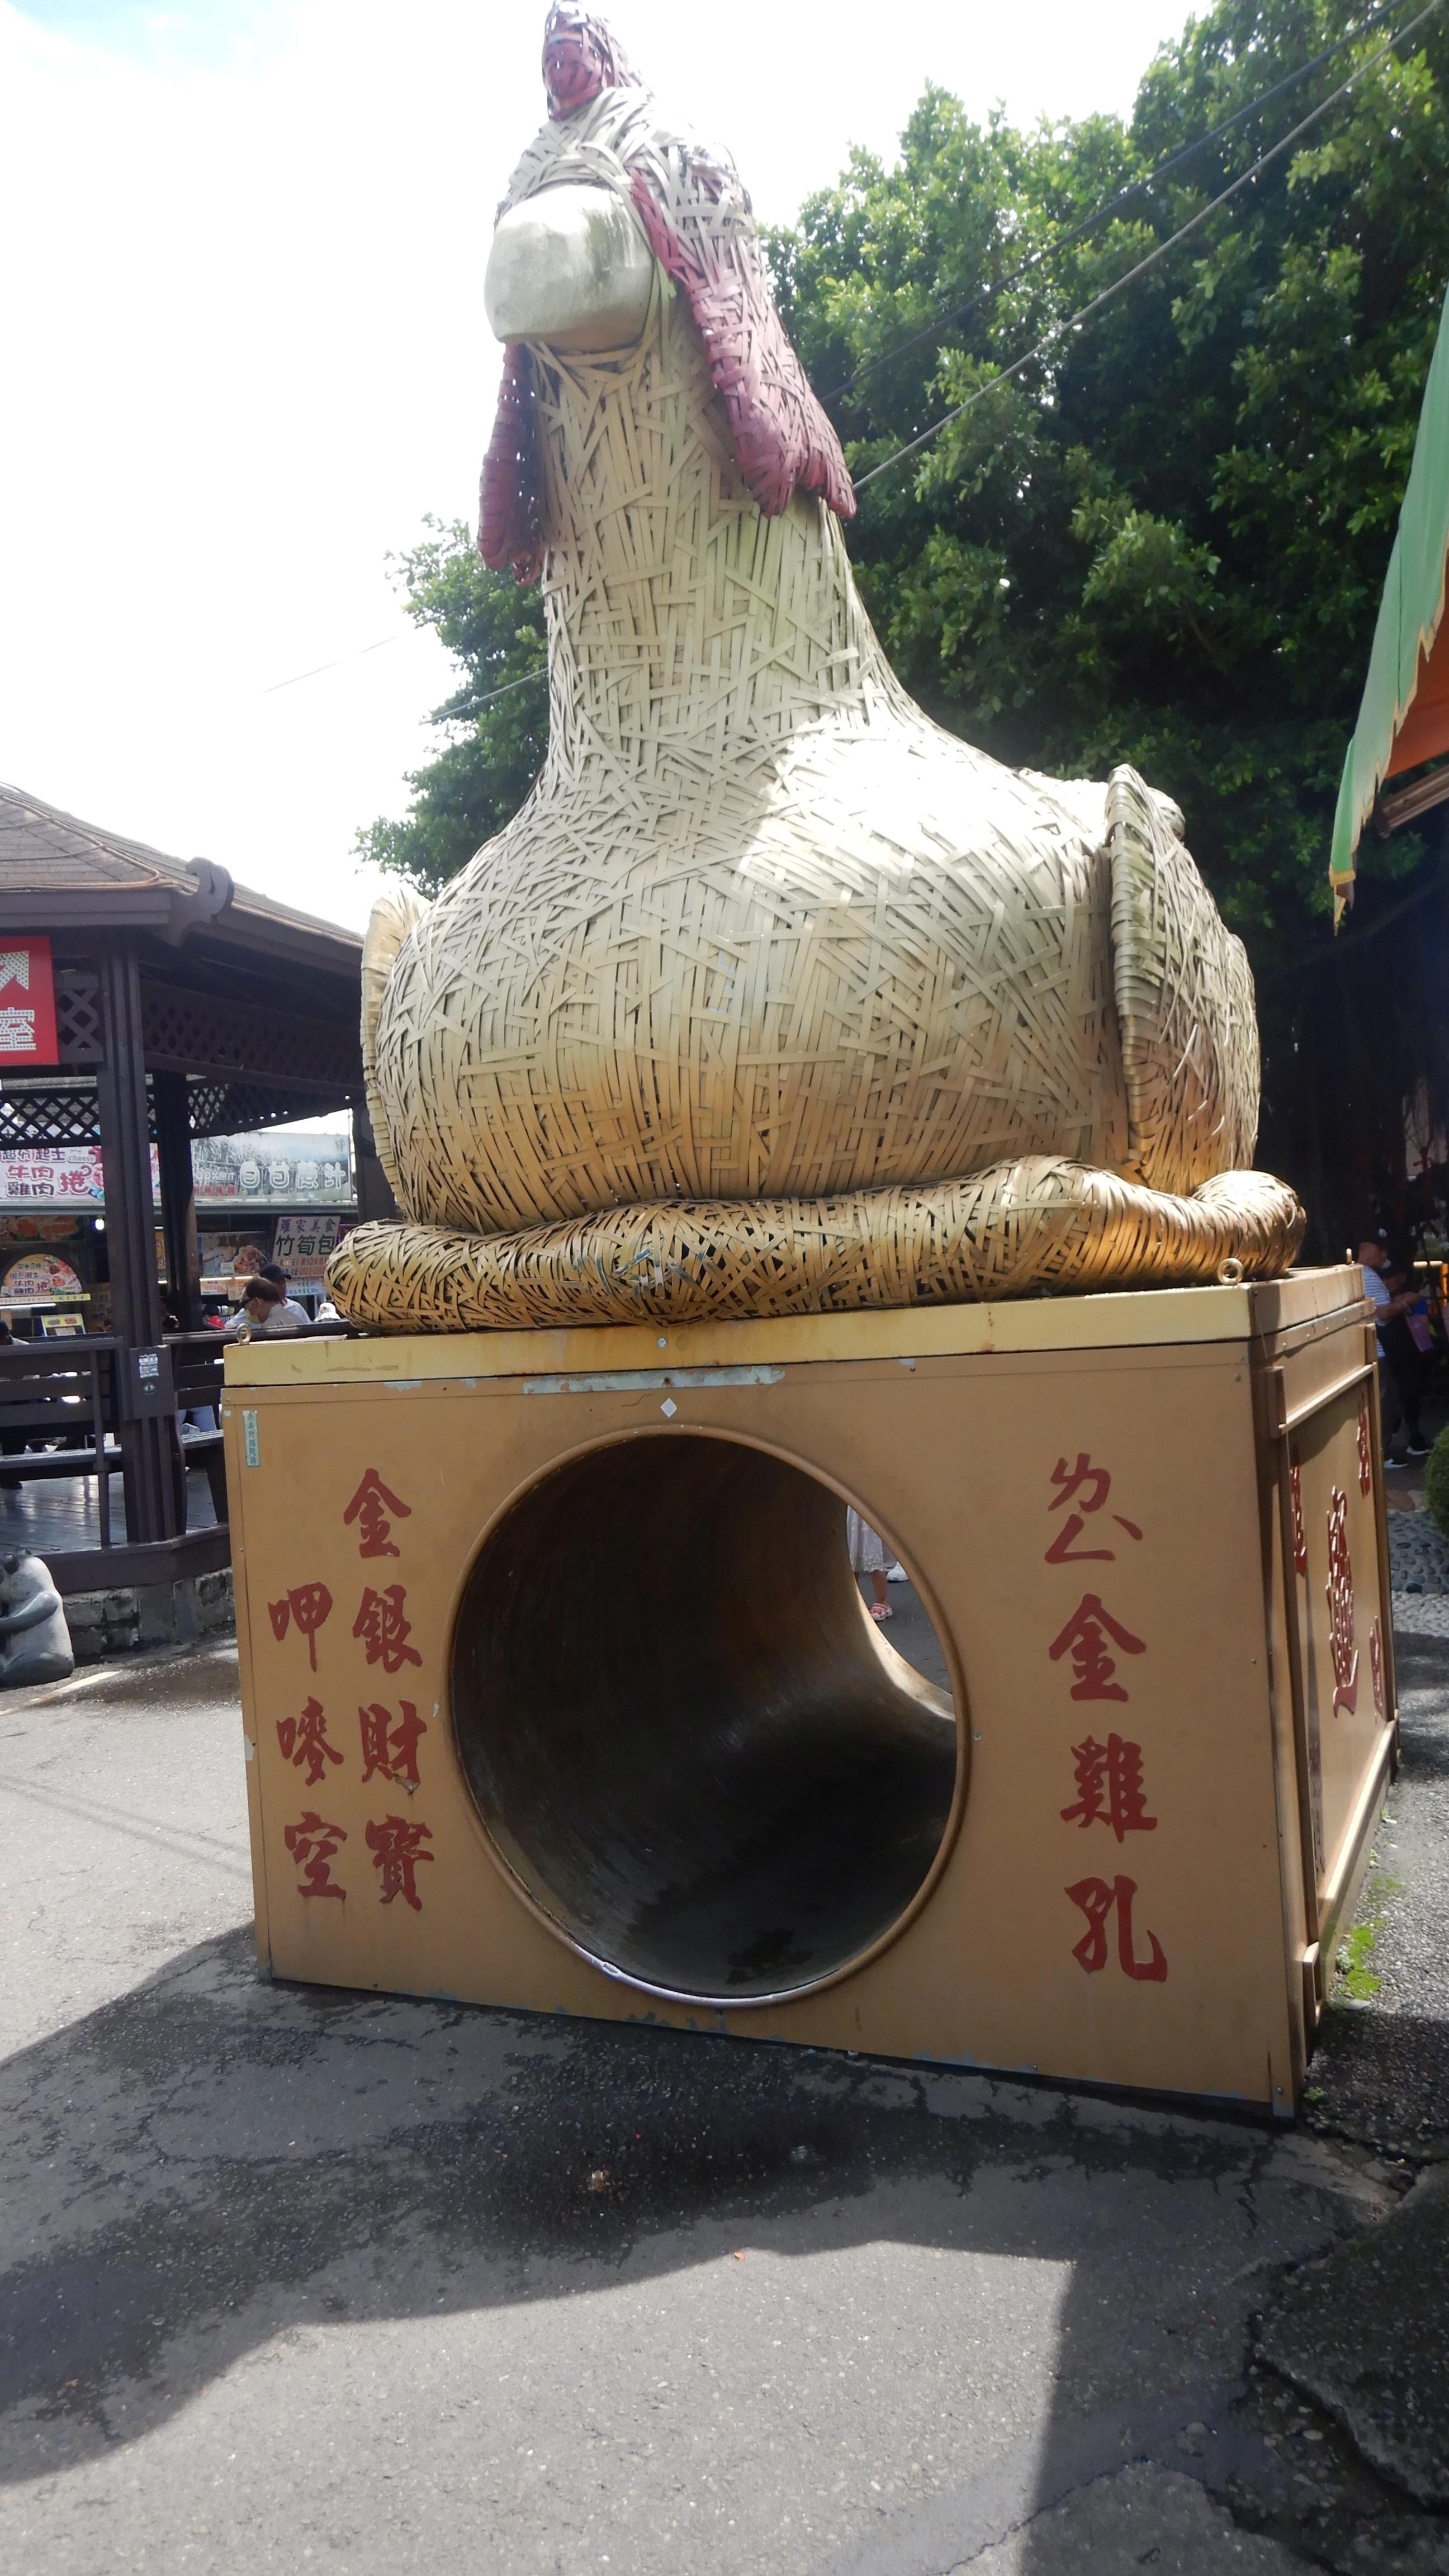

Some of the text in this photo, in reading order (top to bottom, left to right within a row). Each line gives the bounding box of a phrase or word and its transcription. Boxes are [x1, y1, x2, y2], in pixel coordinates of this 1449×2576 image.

[8, 1164, 54, 1179] 牛肉
[59, 1165, 93, 1192] 捲
[7, 1181, 54, 1195] 雞肉
[280, 1218, 335, 1233] 羅家美食
[276, 1234, 335, 1256] 竹筍包
[343, 1467, 435, 1911] 金銀財寶
